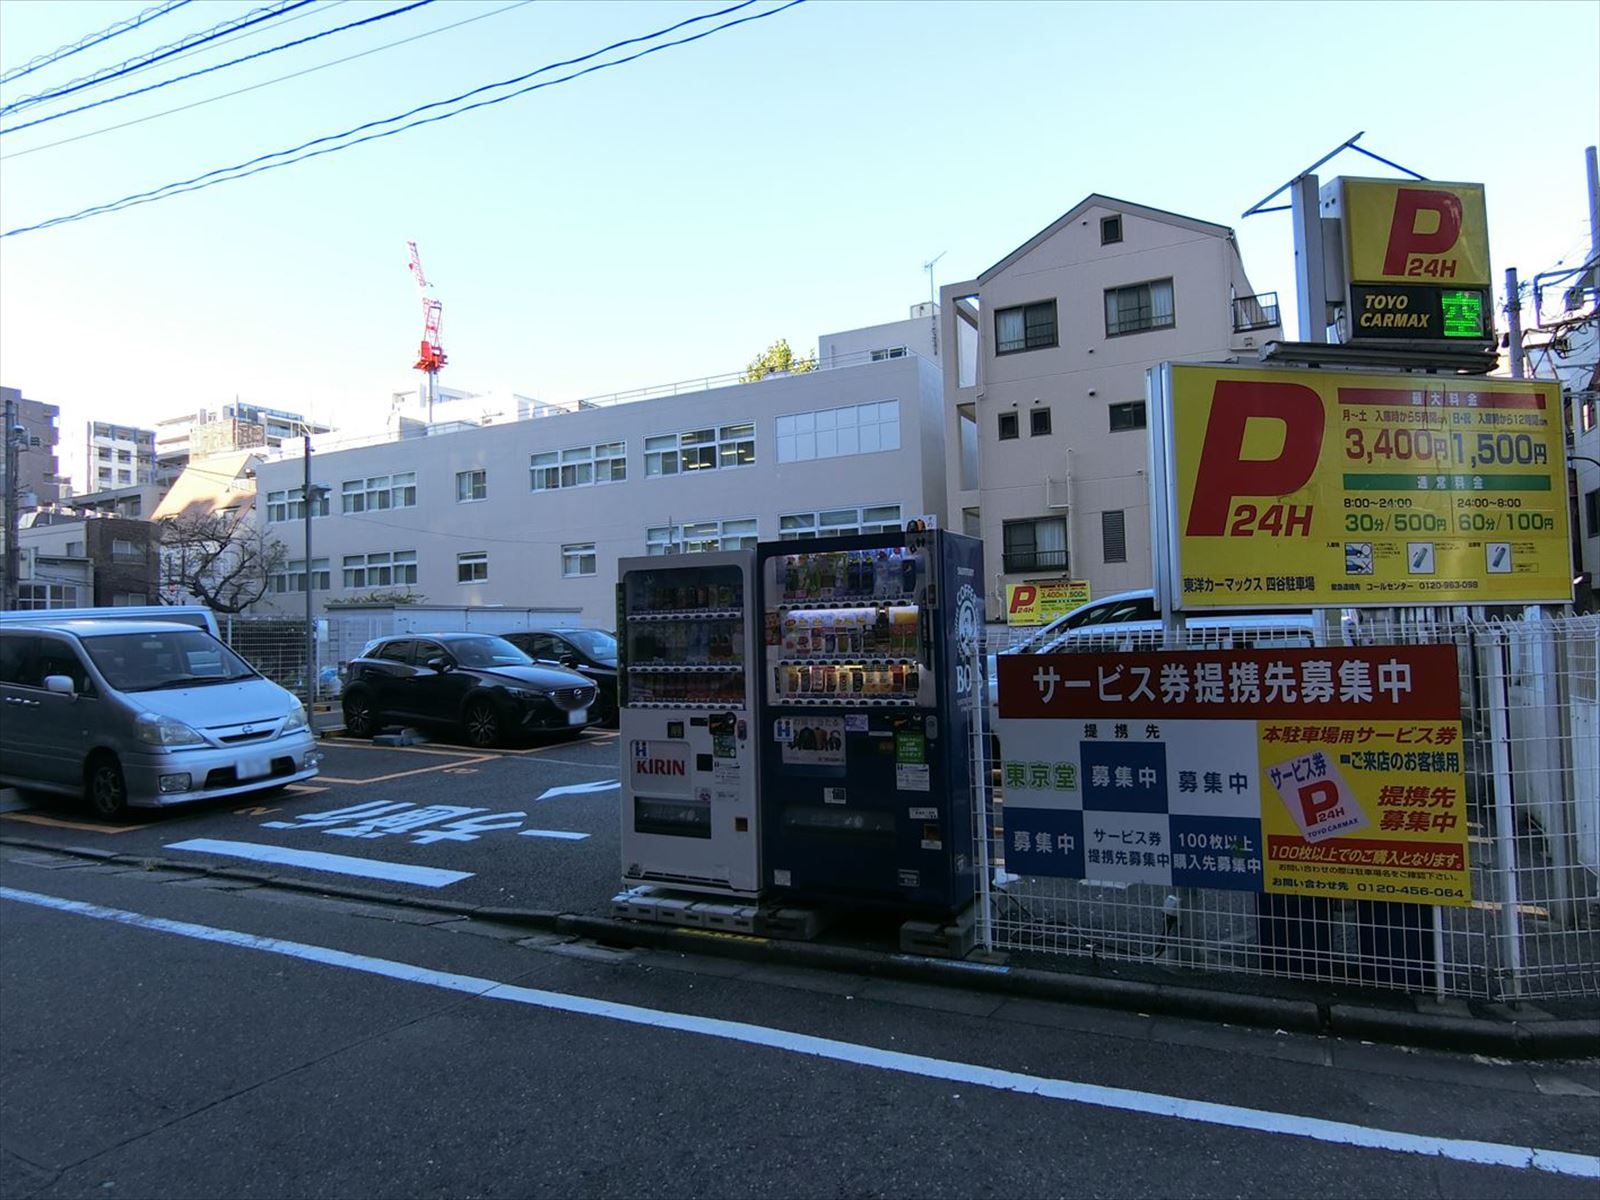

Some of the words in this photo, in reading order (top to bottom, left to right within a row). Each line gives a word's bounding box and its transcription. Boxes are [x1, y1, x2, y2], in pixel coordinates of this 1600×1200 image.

[1382, 188, 1462, 276] P
[1408, 258, 1457, 277] 24H
[1364, 294, 1409, 309] TOYO
[1359, 313, 1430, 328] CARMAX
[1412, 391, 1478, 406] 最大料金
[1345, 427, 1448, 464] 3,400円
[1452, 432, 1547, 468] 1,500円
[1185, 379, 1325, 536] P
[1417, 475, 1484, 490] 通常料金
[1230, 504, 1314, 537] 24H
[1344, 513, 1447, 532] 30分/500円
[1459, 512, 1554, 531] 60分/100円
[1183, 577, 1263, 593] 東洋カーマックス
[1266, 576, 1315, 591] 四谷駐車場
[1366, 582, 1414, 591] コールセンター
[1009, 586, 1037, 613] P
[955, 663, 984, 693] BOS
[1032, 658, 1412, 705] サービス券提携先募集中
[1263, 726, 1458, 745] 本駐車場用サービス券
[637, 758, 685, 775] KIRIN
[1270, 752, 1327, 790] サービス券
[1350, 751, 1459, 772] ご来店のお客様用
[1005, 761, 1078, 791] 東京堂
[1091, 765, 1157, 788] 募集中
[1178, 770, 1248, 794] 募集中
[1298, 780, 1339, 827] P
[1377, 785, 1456, 809] 提携先
[1318, 807, 1345, 822] 24H
[1379, 810, 1457, 833] 募集中
[1093, 828, 1161, 846] サービス券
[1307, 829, 1328, 838] TOYO
[1328, 818, 1358, 833] CARMAX
[1013, 830, 1075, 855] 募集中
[1178, 832, 1253, 852] 100枚以上
[1088, 849, 1170, 867] 提携先募集中
[1173, 853, 1261, 872] 購入先募集中
[1270, 845, 1462, 869] 100枚以上でのご購入となります。
[1272, 877, 1349, 891] お問い合わせ先
[1357, 883, 1465, 898] 0120-456-064
